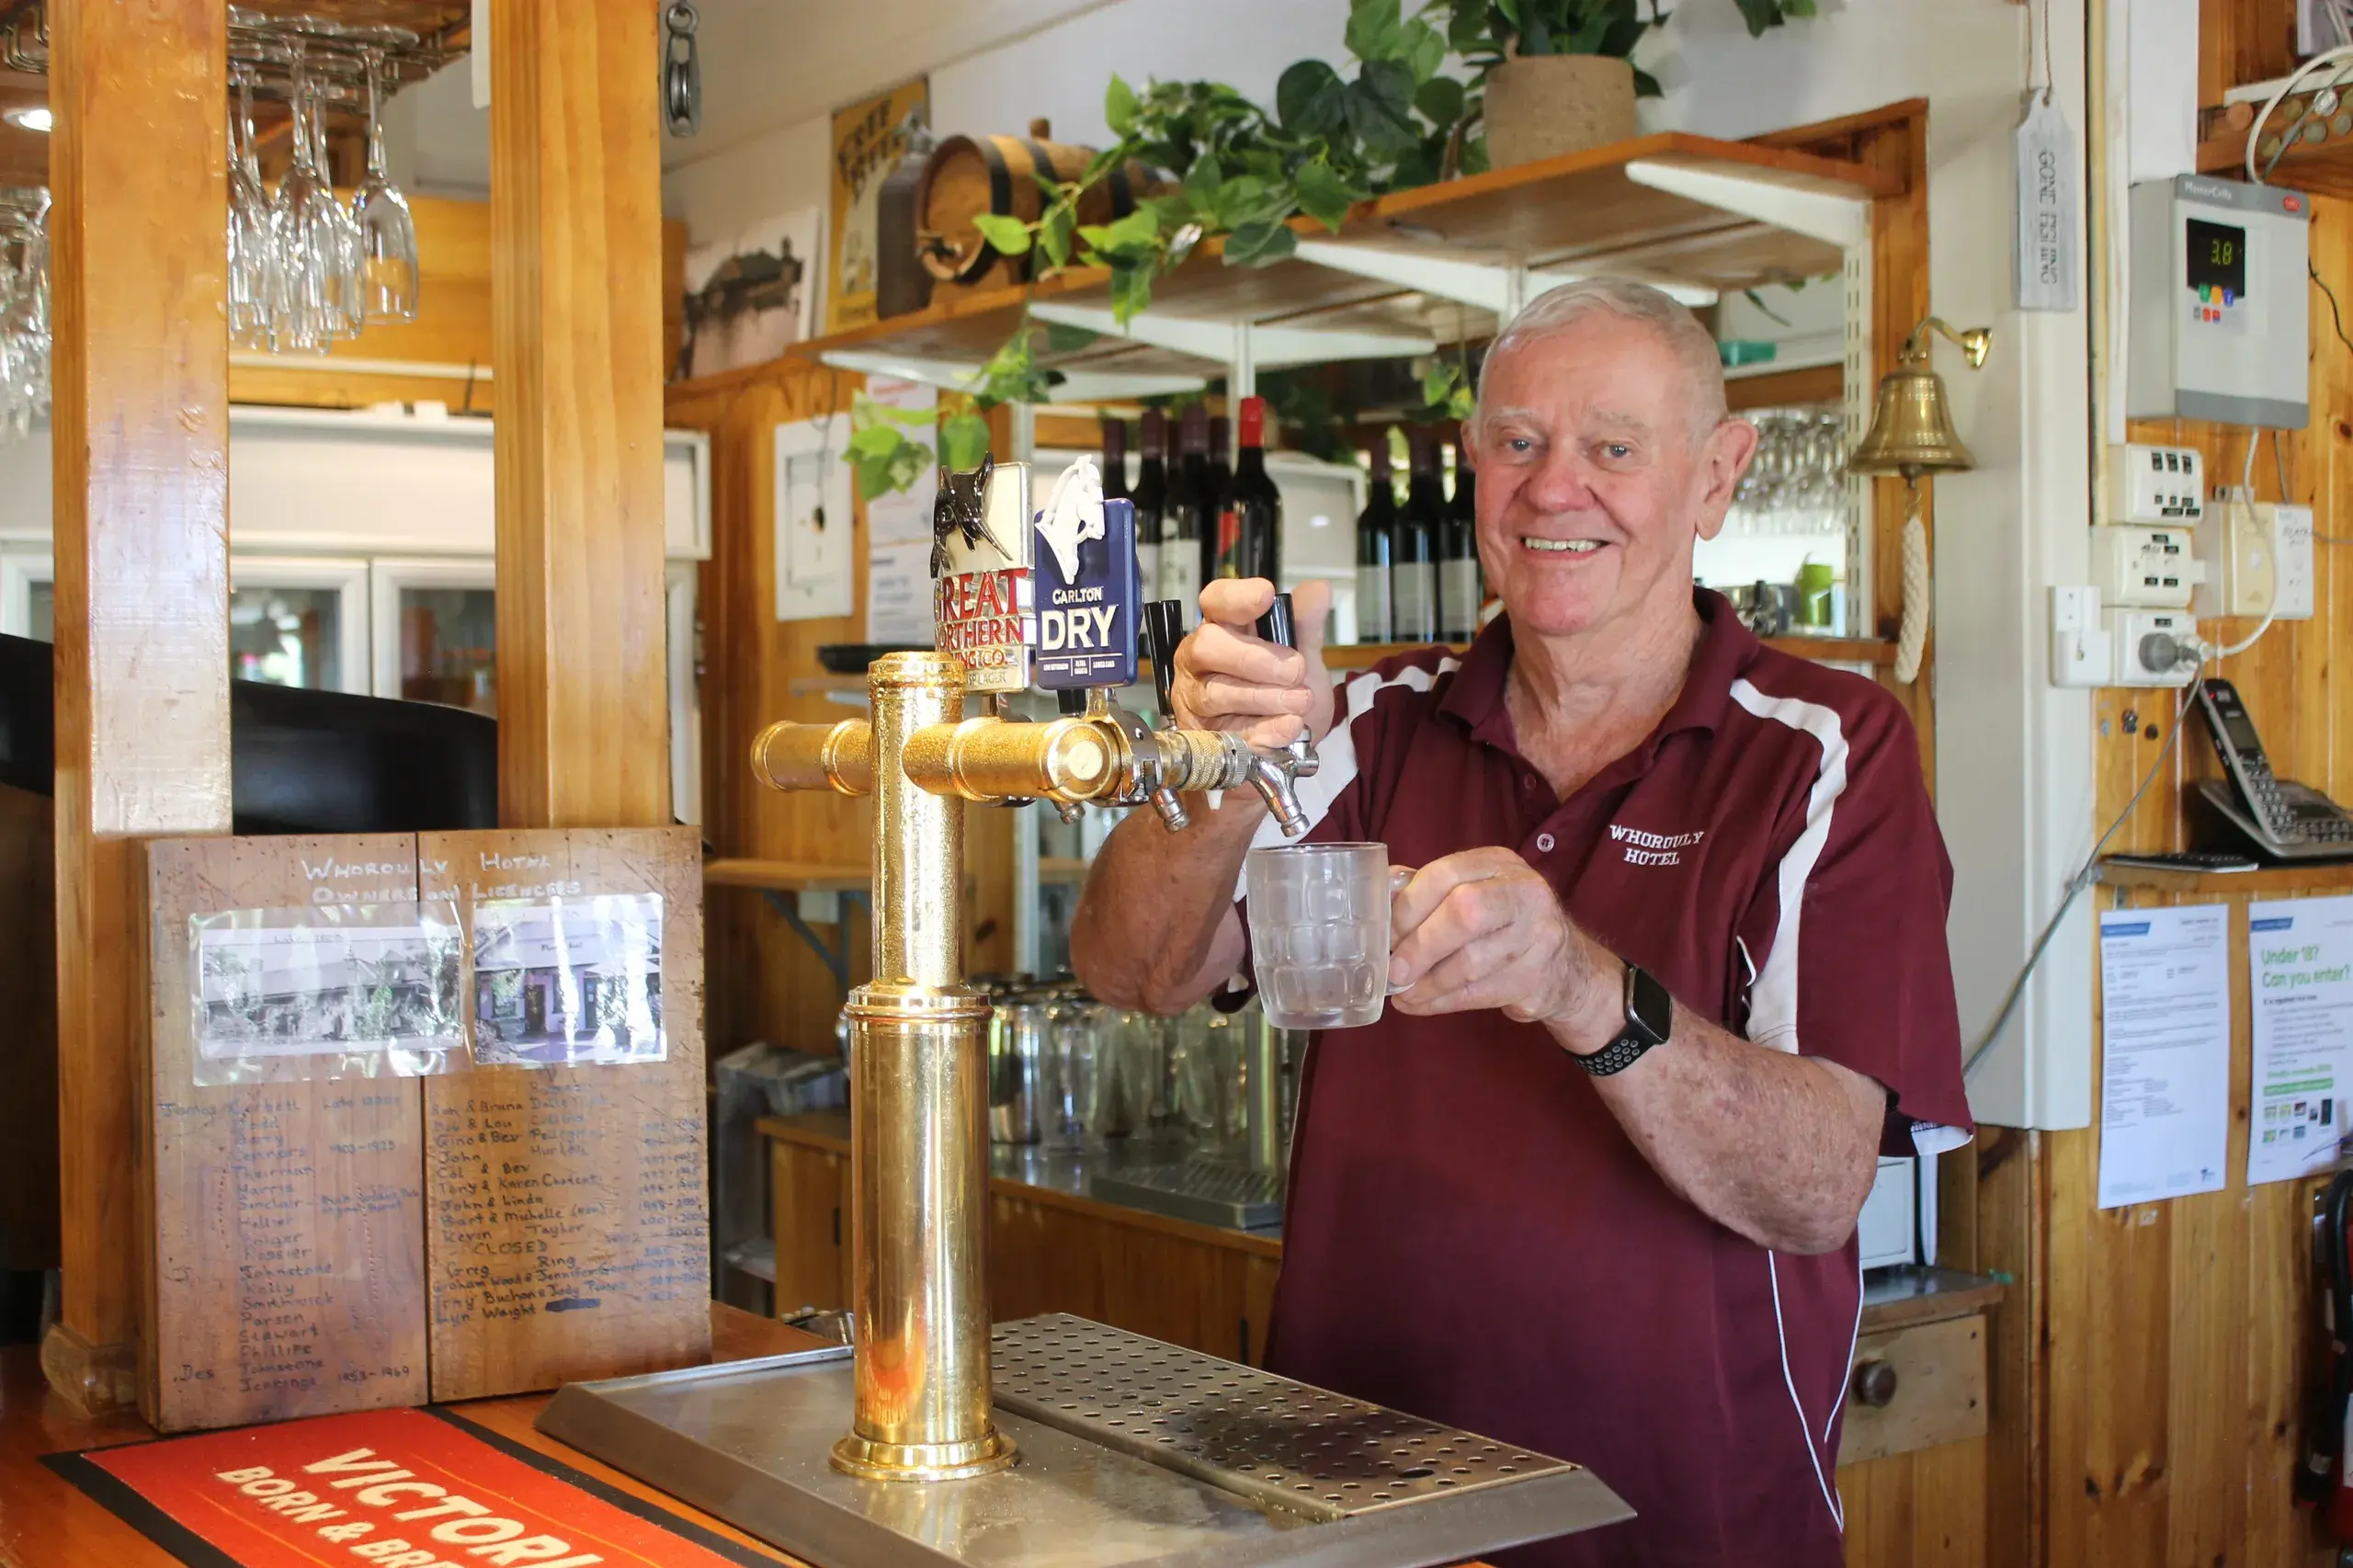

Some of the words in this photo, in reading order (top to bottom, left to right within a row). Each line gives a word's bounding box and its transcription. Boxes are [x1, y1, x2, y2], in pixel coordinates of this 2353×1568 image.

[2039, 148, 2055, 204] GONE
[2211, 238, 2234, 265] 3.8
[1052, 587, 1103, 605] CARLTON
[1040, 604, 1119, 651] DRY
[953, 650, 978, 670] ING
[981, 649, 1009, 667] CO.
[1609, 824, 1705, 849] WHOROULY
[1623, 847, 1680, 866] HOTEL
[2261, 949, 2299, 965] Under
[2262, 970, 2288, 988] Can
[2290, 970, 2312, 989] you
[2313, 965, 2350, 983] enter?
[472, 1238, 548, 1256] CLOSED
[537, 1255, 576, 1270] Ring
[216, 1466, 348, 1524] BORN
[316, 1521, 375, 1543] &
